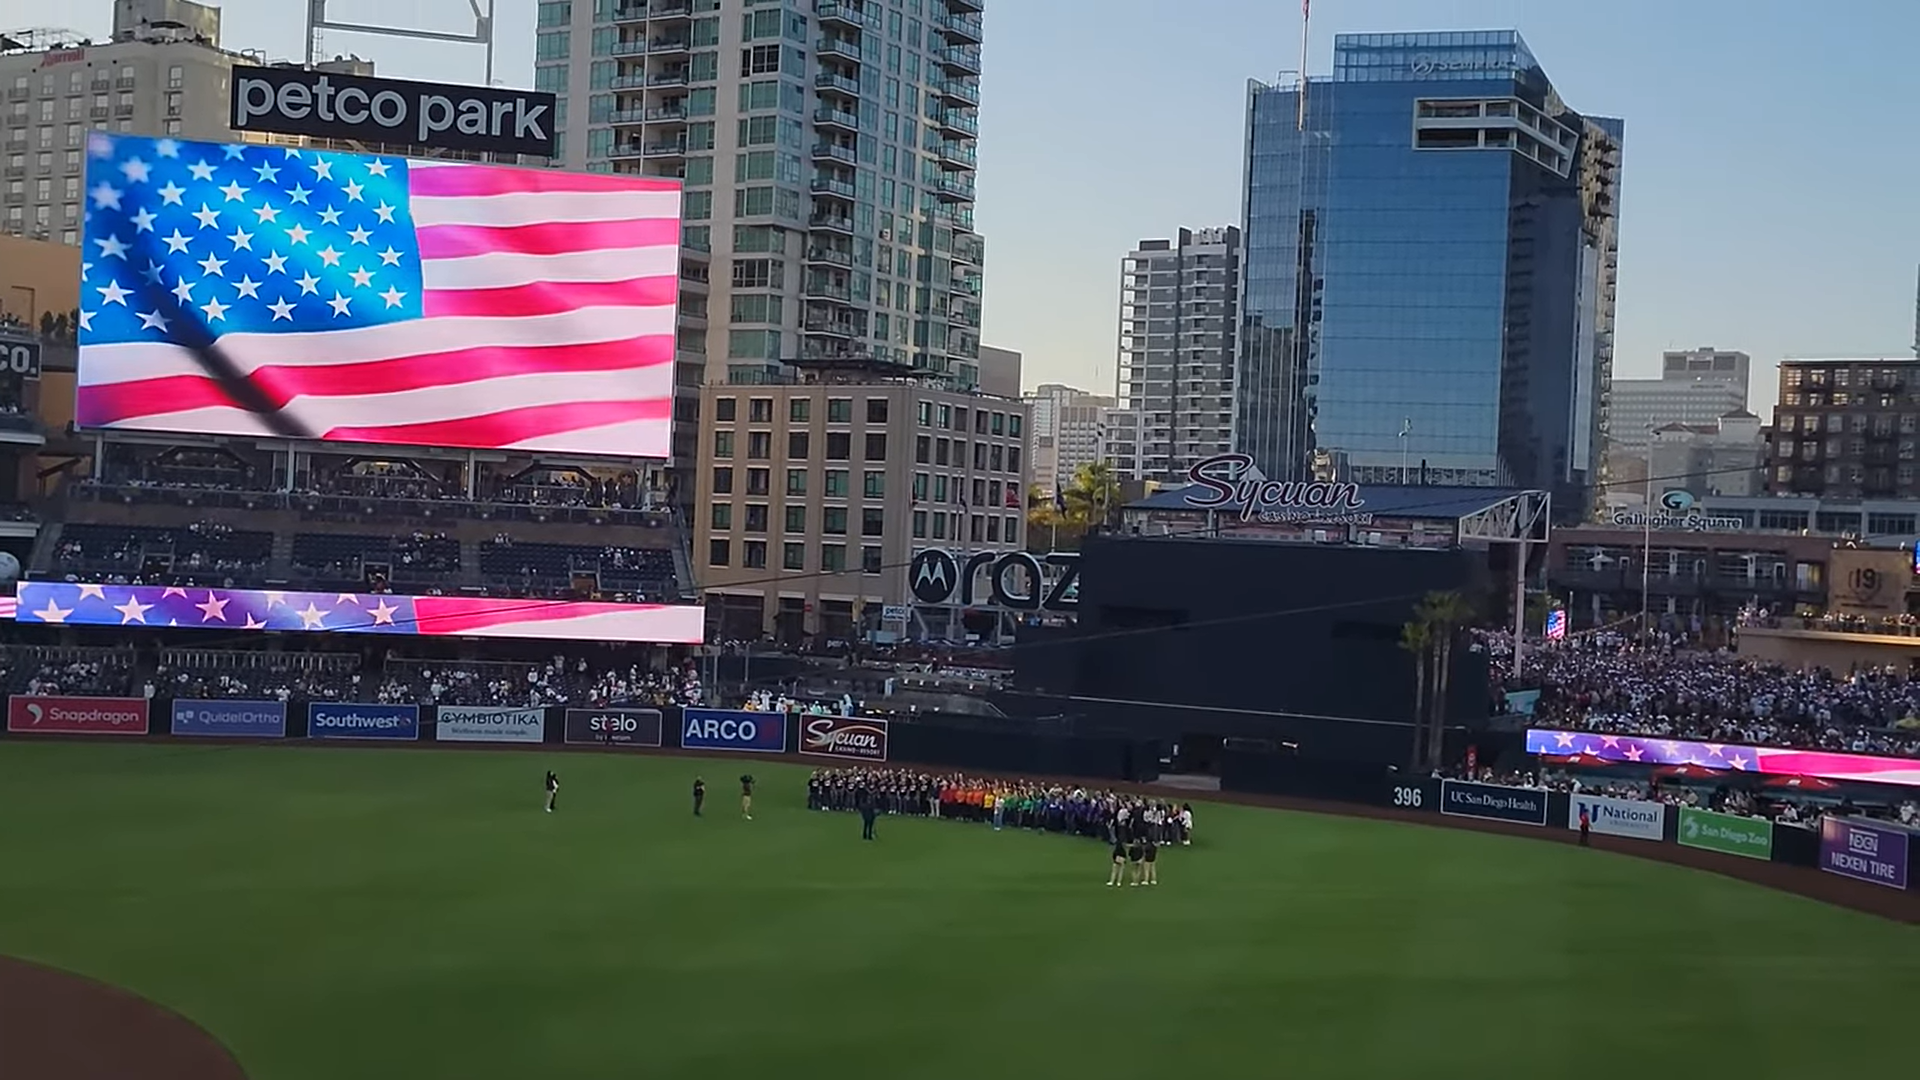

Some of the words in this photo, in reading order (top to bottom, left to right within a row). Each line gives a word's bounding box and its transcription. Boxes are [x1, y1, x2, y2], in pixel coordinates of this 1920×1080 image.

[237, 76, 407, 127] petco
[418, 94, 548, 141] park
[1184, 453, 1365, 523] Sycuan
[1612, 512, 1683, 530] Gallagher
[1688, 514, 1743, 532] Square
[1856, 568, 1876, 589] 19
[50, 707, 139, 725] Snapdragon
[199, 710, 281, 725] QuidelOrtho
[315, 712, 400, 729] Southwest
[590, 713, 637, 732] stelo
[685, 718, 757, 741] ARCO
[806, 719, 878, 752] Sycuan
[1393, 786, 1422, 807] 396
[1451, 791, 1465, 803] UC
[1465, 792, 1482, 804] San
[1483, 794, 1507, 810] Diego
[1508, 797, 1537, 812] Health
[1603, 806, 1657, 823] National
[1701, 824, 1719, 837] San
[1720, 827, 1748, 844] Diego
[1748, 832, 1768, 846] Zoo
[1831, 852, 1868, 873] NEXEN
[1870, 860, 1895, 879] TIRE
